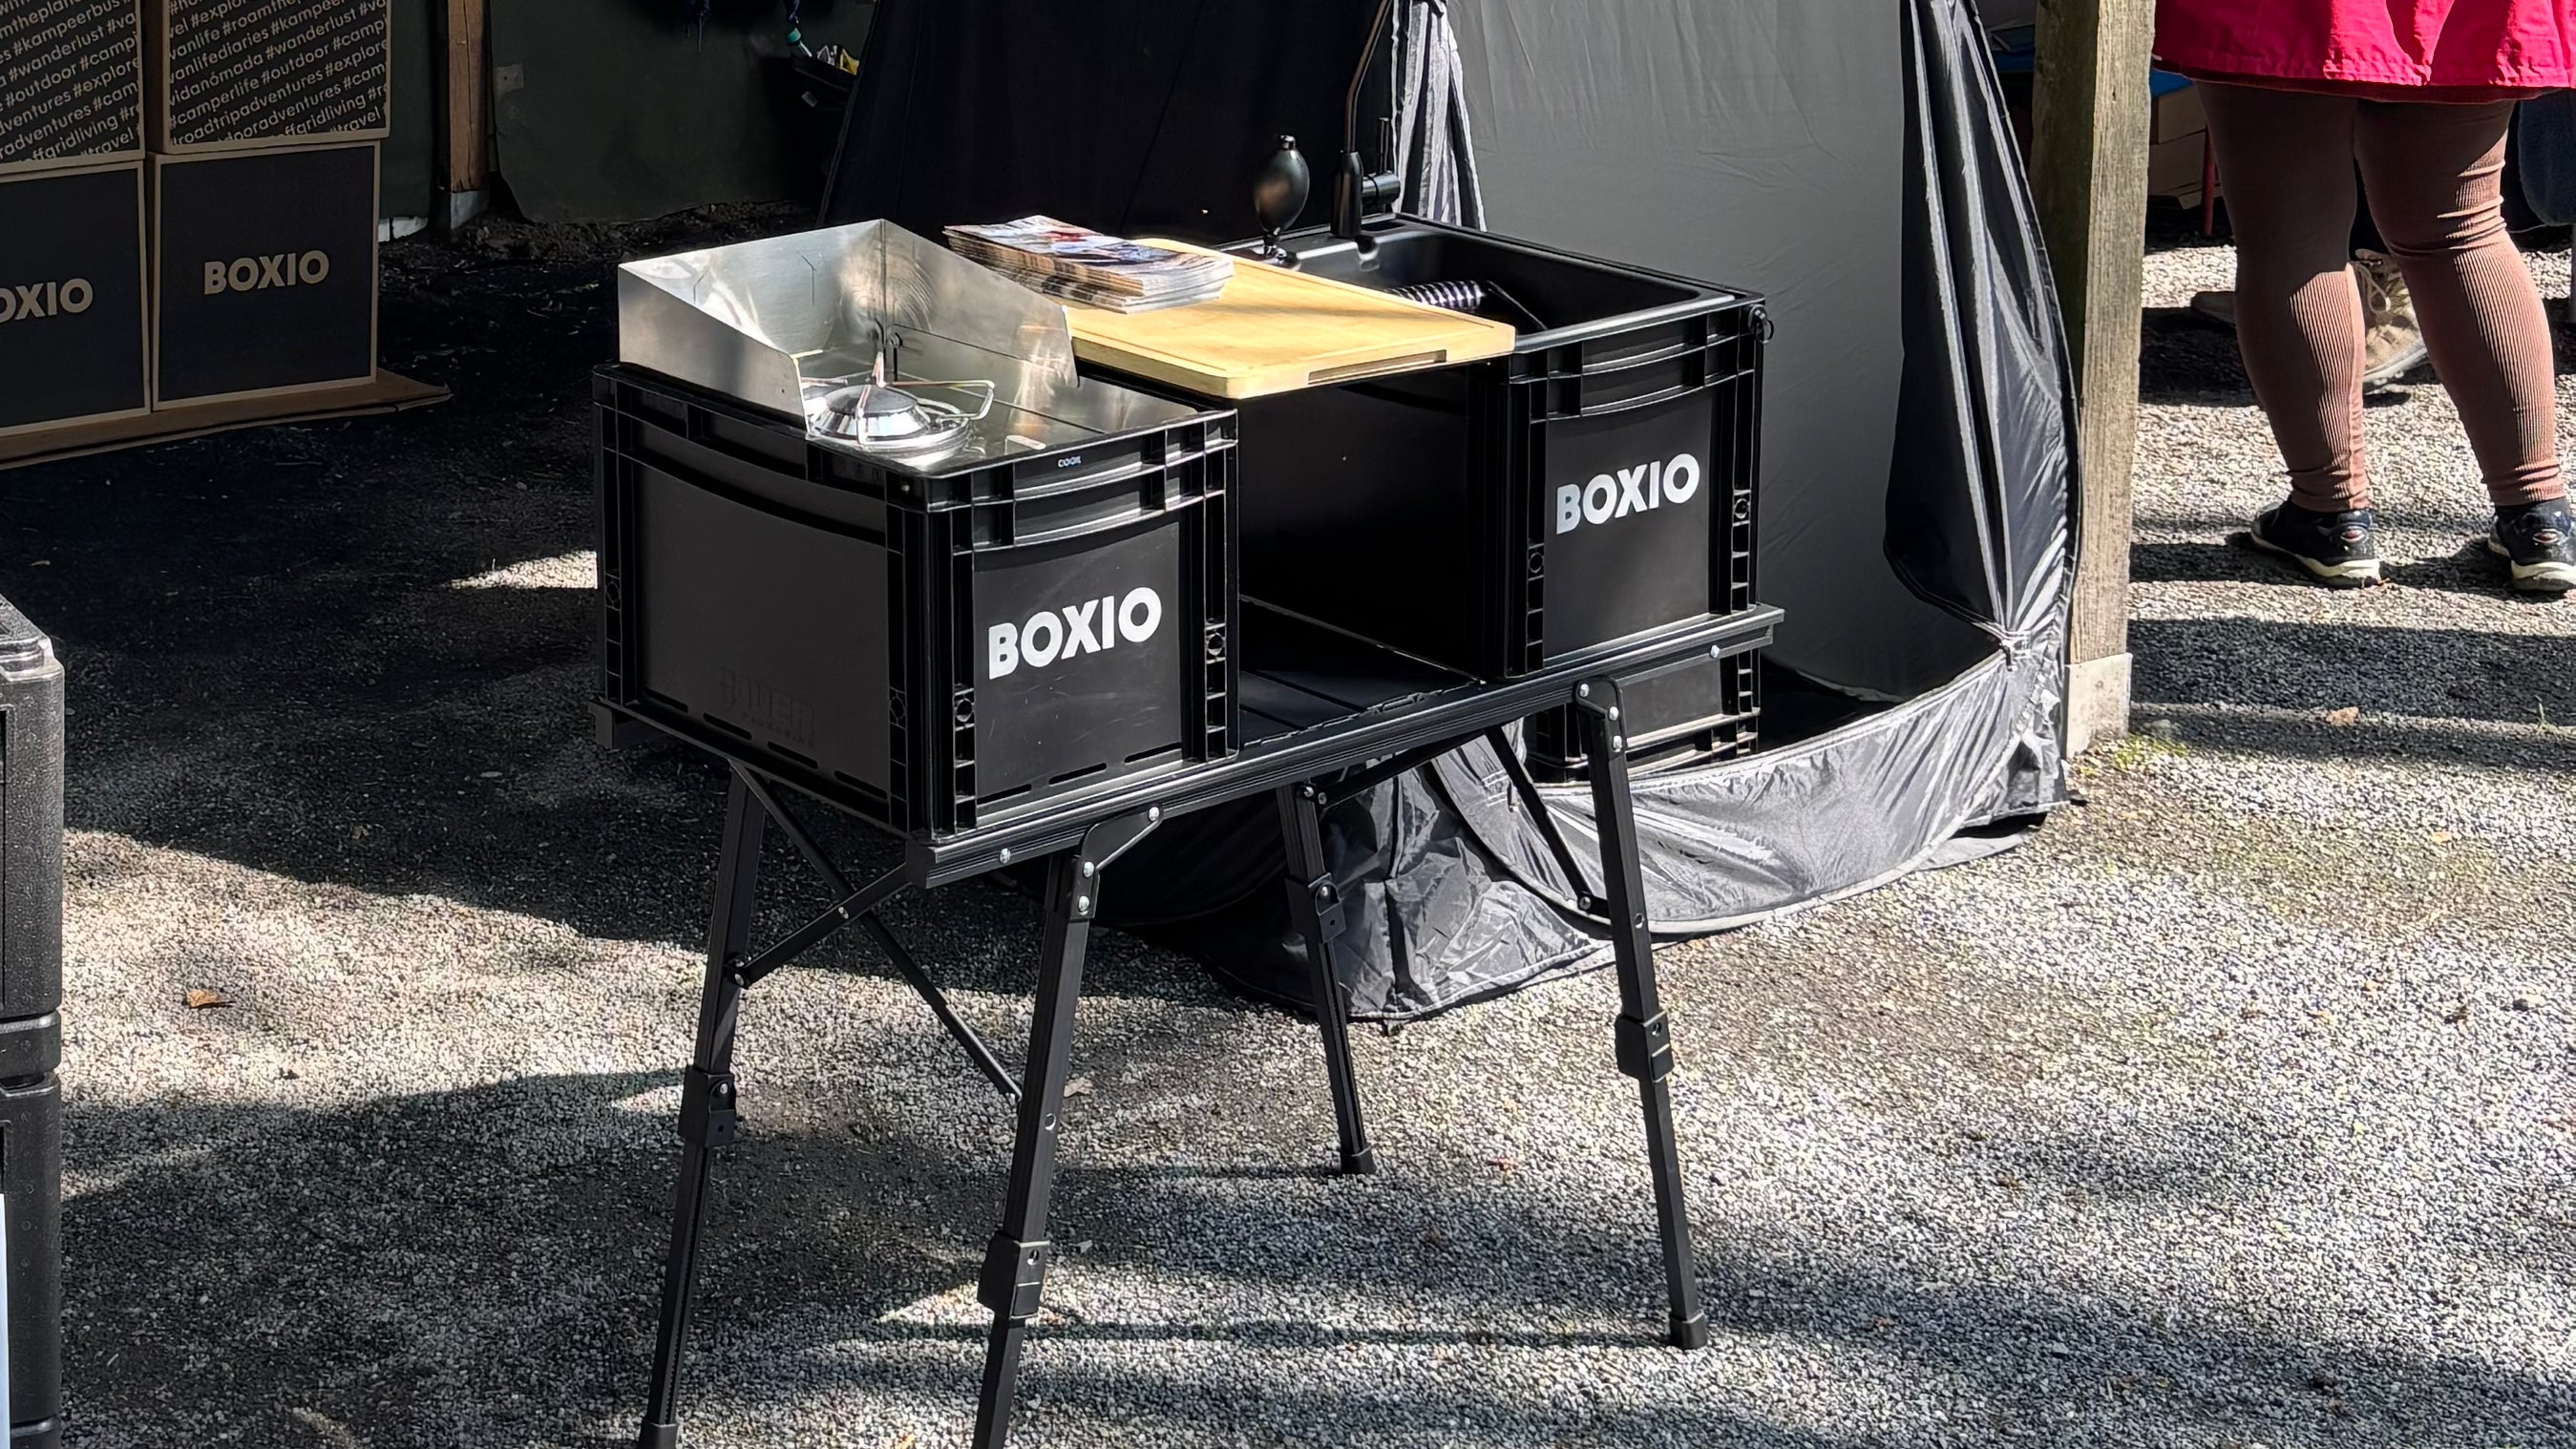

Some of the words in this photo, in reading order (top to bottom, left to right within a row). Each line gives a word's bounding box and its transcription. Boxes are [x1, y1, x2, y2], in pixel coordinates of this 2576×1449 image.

[12, 0, 120, 56] #kampeerbus
[191, 0, 247, 29] #explo
[265, 8, 357, 60] #wanderlust
[270, 0, 346, 35] #kampee
[9, 25, 104, 82] #wanderlust
[261, 44, 329, 85] #outdoor
[6, 63, 76, 108] #outdoor
[203, 249, 330, 295] BOXIO
[1555, 452, 1700, 536] BOXIO
[988, 586, 1162, 680] BOXIO
